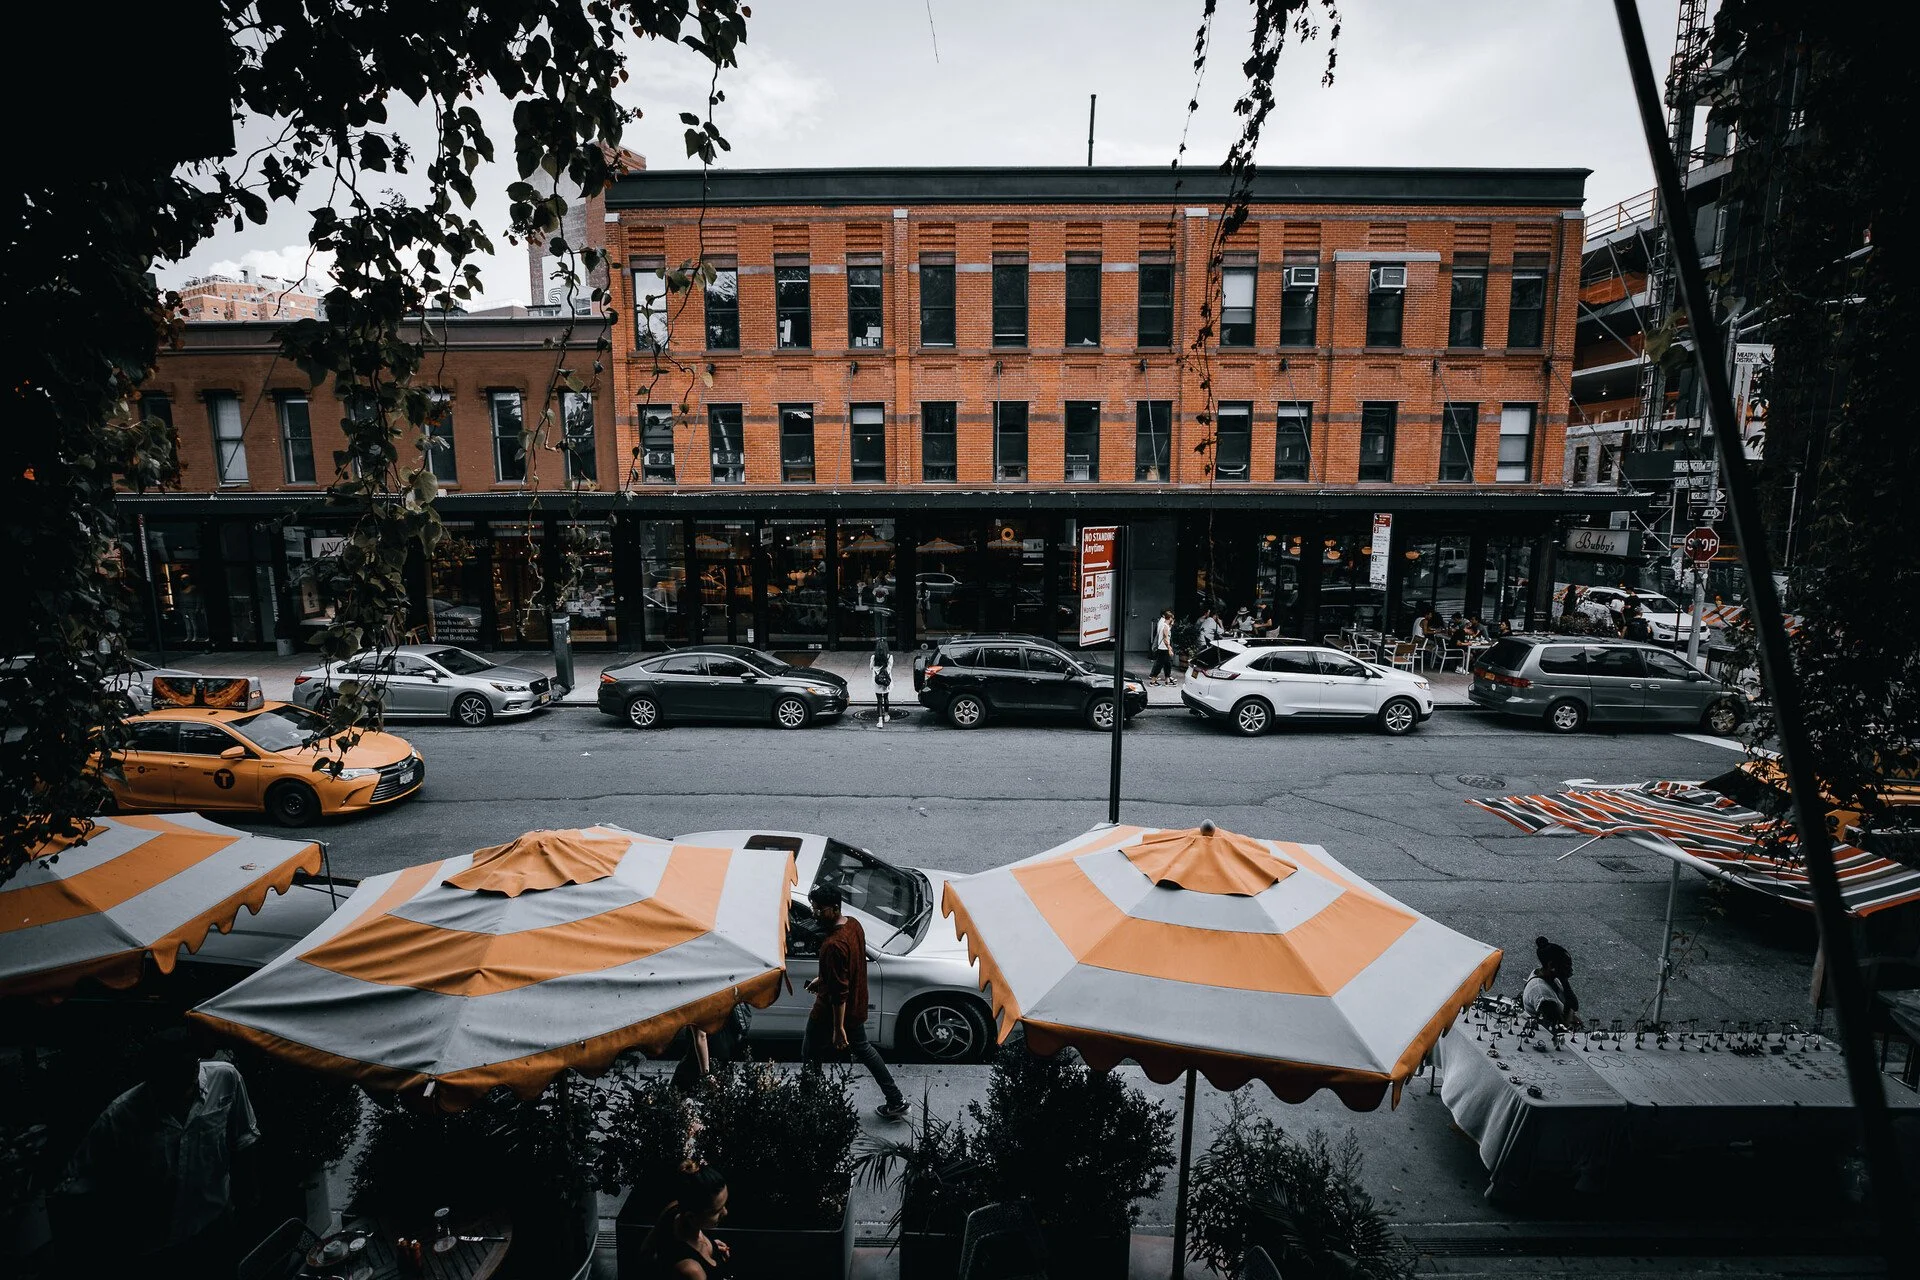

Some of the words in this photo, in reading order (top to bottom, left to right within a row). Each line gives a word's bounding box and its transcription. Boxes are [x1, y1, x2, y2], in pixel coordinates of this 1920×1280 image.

[1675, 463, 1706, 471] WASHNGTON
[1675, 477, 1704, 487] GANSEOORT
[1085, 533, 1092, 542] NO
[1093, 532, 1115, 542] STANDING
[1575, 531, 1615, 553] Bubby's
[1085, 544, 1105, 554] Anytime
[1687, 538, 1717, 552] SOP
[1097, 575, 1107, 583] Truck
[1097, 582, 1110, 591] Loading
[1083, 606, 1096, 614] Monday
[1100, 603, 1110, 611] Friday
